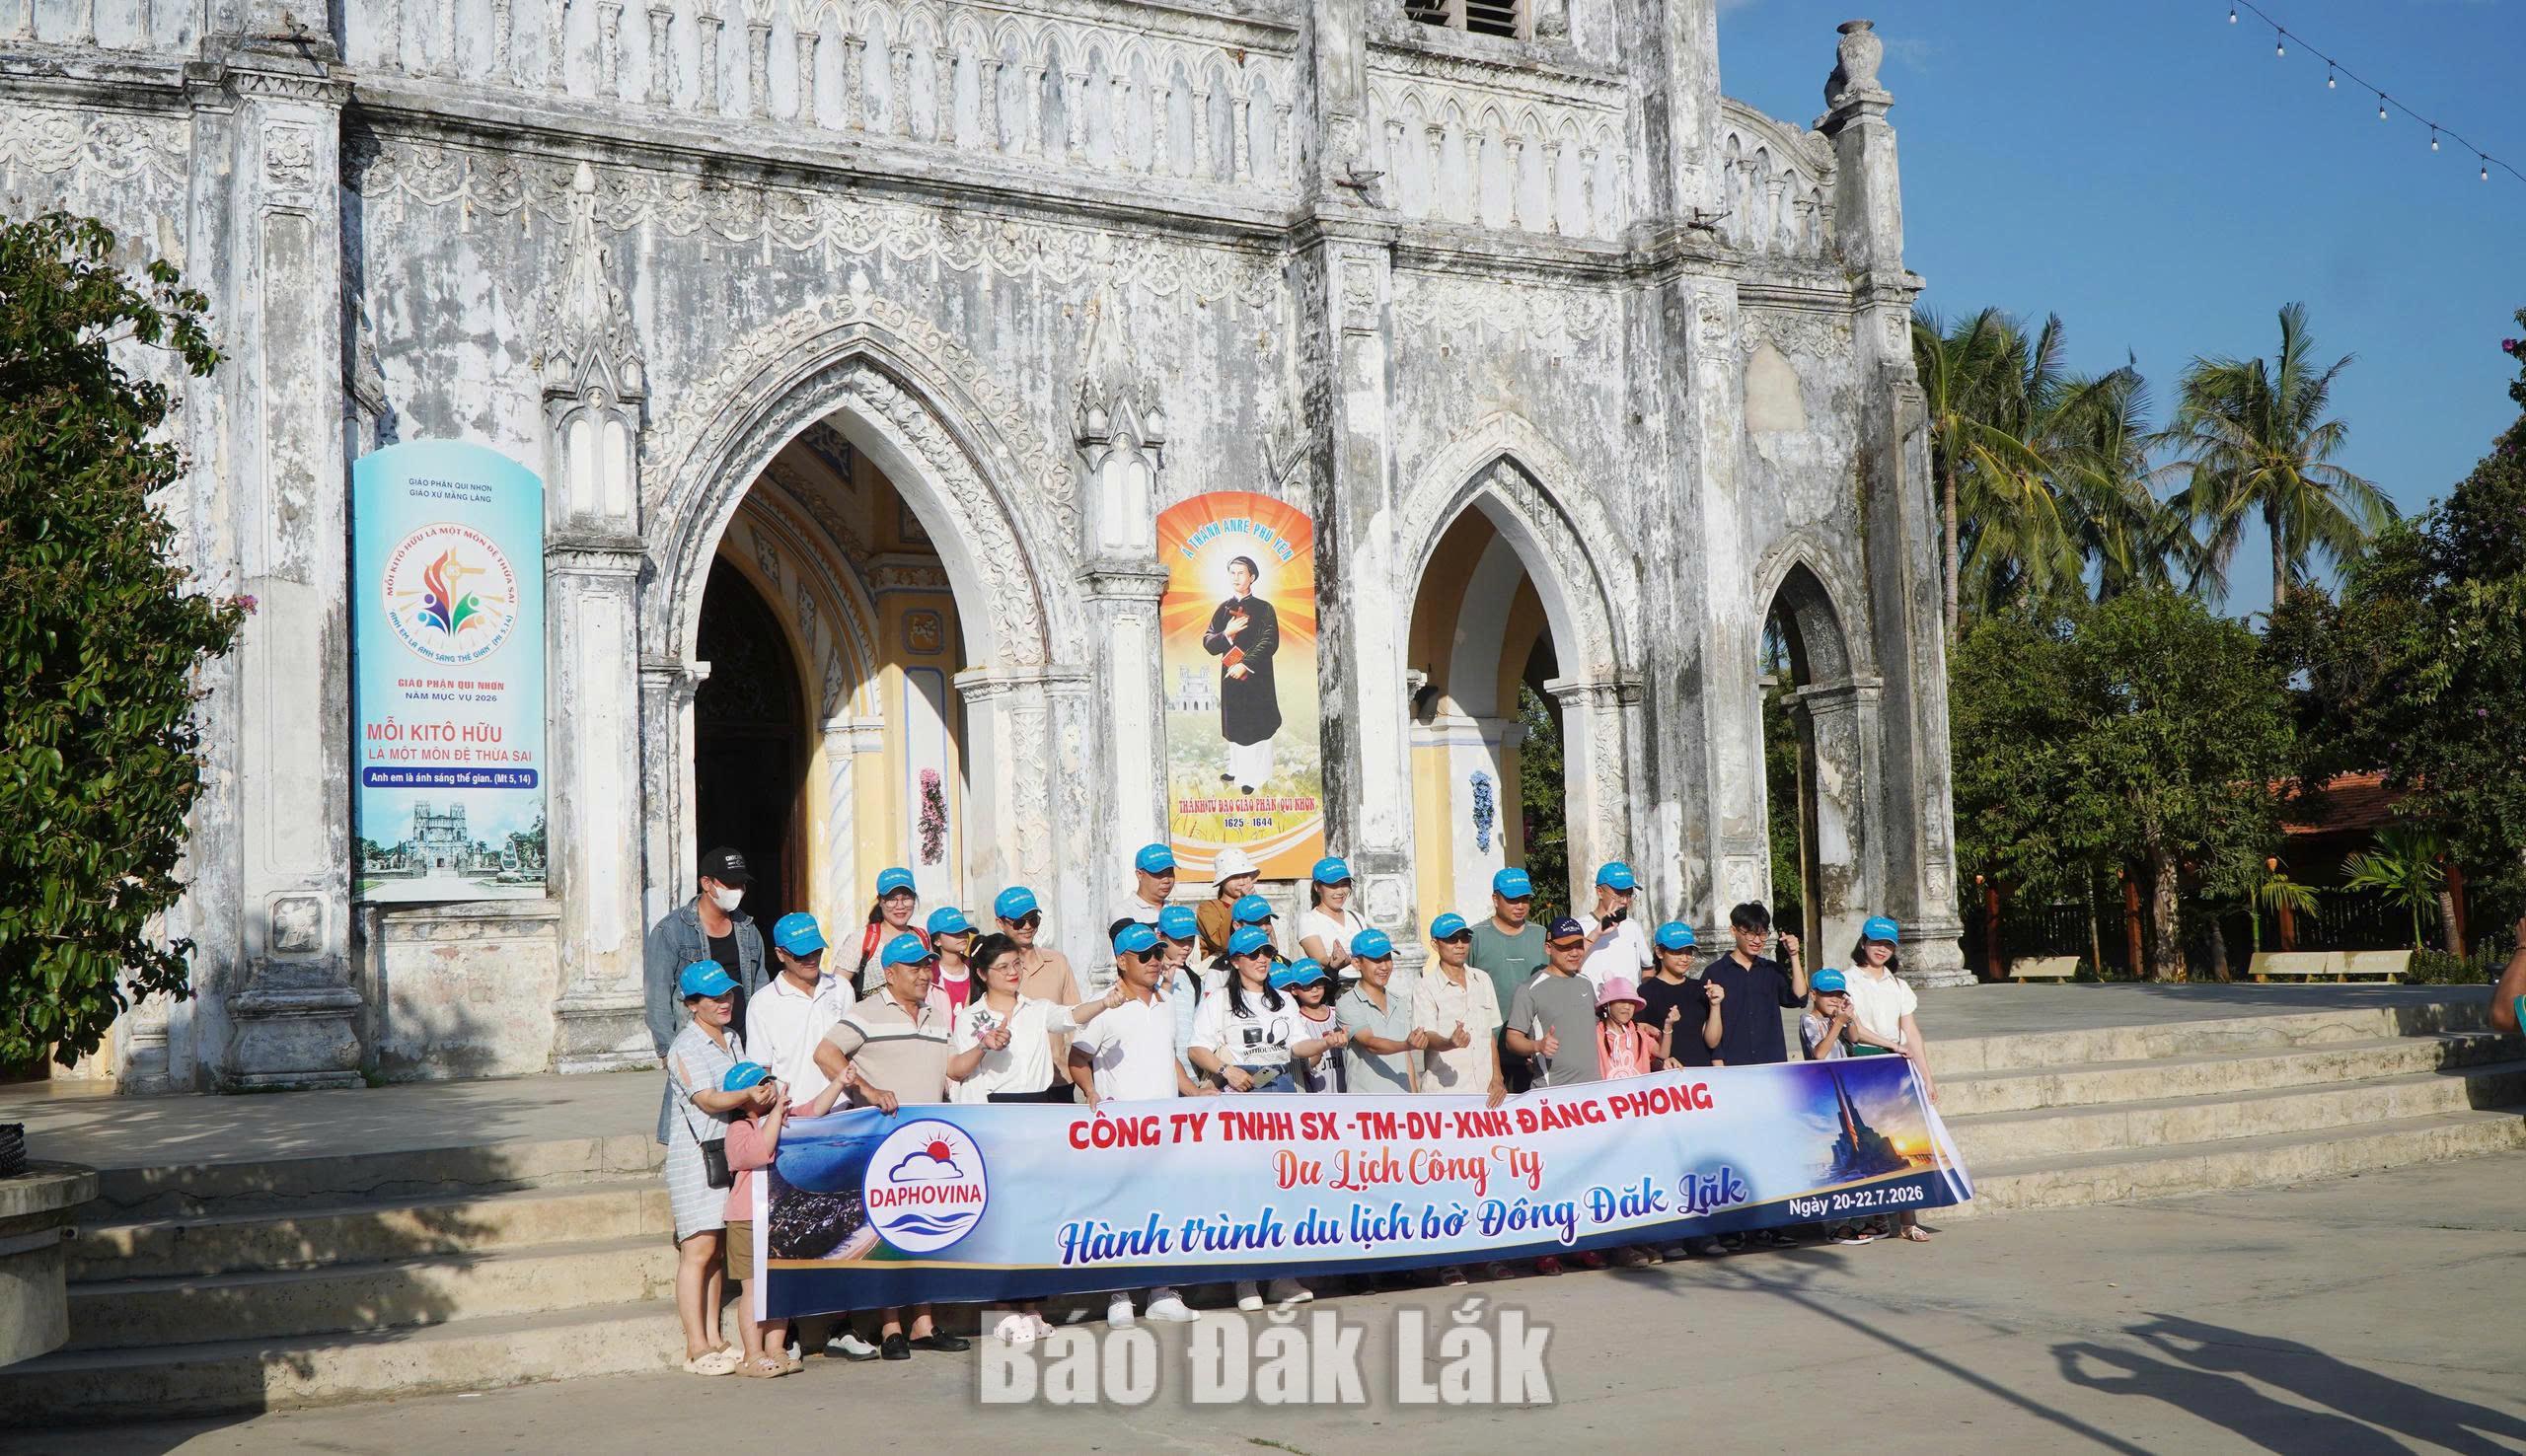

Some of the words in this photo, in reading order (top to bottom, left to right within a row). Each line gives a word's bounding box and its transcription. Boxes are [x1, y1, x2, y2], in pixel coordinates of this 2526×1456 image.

[458, 681, 474, 690] QUI
[367, 715, 403, 740] MỖI
[410, 721, 456, 742] KITÔ
[463, 722, 502, 742] HỮU
[369, 746, 385, 760] LÀ
[390, 746, 416, 763] MỘT
[422, 747, 450, 761] MÔN
[454, 747, 471, 763] ĐỆ
[513, 750, 531, 762] SAI
[371, 773, 389, 782] Anh
[406, 773, 414, 782] là
[415, 773, 432, 783] ánh
[434, 773, 456, 785] sáng
[457, 771, 472, 783] thế
[473, 775, 492, 785] gian.
[494, 774, 507, 784] (Mt
[519, 774, 531, 785] 14)
[1225, 818, 1243, 828] 1625
[1253, 817, 1272, 827] 1644
[1070, 1111, 1161, 1149] CÔNG
[1170, 1112, 1209, 1143] TY
[1219, 1111, 1295, 1141] TNHH
[1301, 1111, 1340, 1141] SX
[1516, 1099, 1607, 1134] ĐĂNG
[1608, 1082, 1714, 1119] PHONG
[1272, 1149, 1323, 1190] Du
[1329, 1145, 1404, 1192] Lịch
[1408, 1147, 1490, 1198] Công
[1491, 1144, 1544, 1191] Ty
[869, 1184, 982, 1208] DAPHOVINA
[1789, 1197, 1829, 1218] Ngày
[1833, 1185, 1924, 1211] 20-22.7.2026
[1058, 1212, 1173, 1265] Hành
[1180, 1206, 1294, 1252] trình
[1294, 1207, 1343, 1247] du
[1351, 1202, 1414, 1250] lịch
[1421, 1202, 1470, 1241] bờ
[1476, 1198, 1579, 1244] Đông
